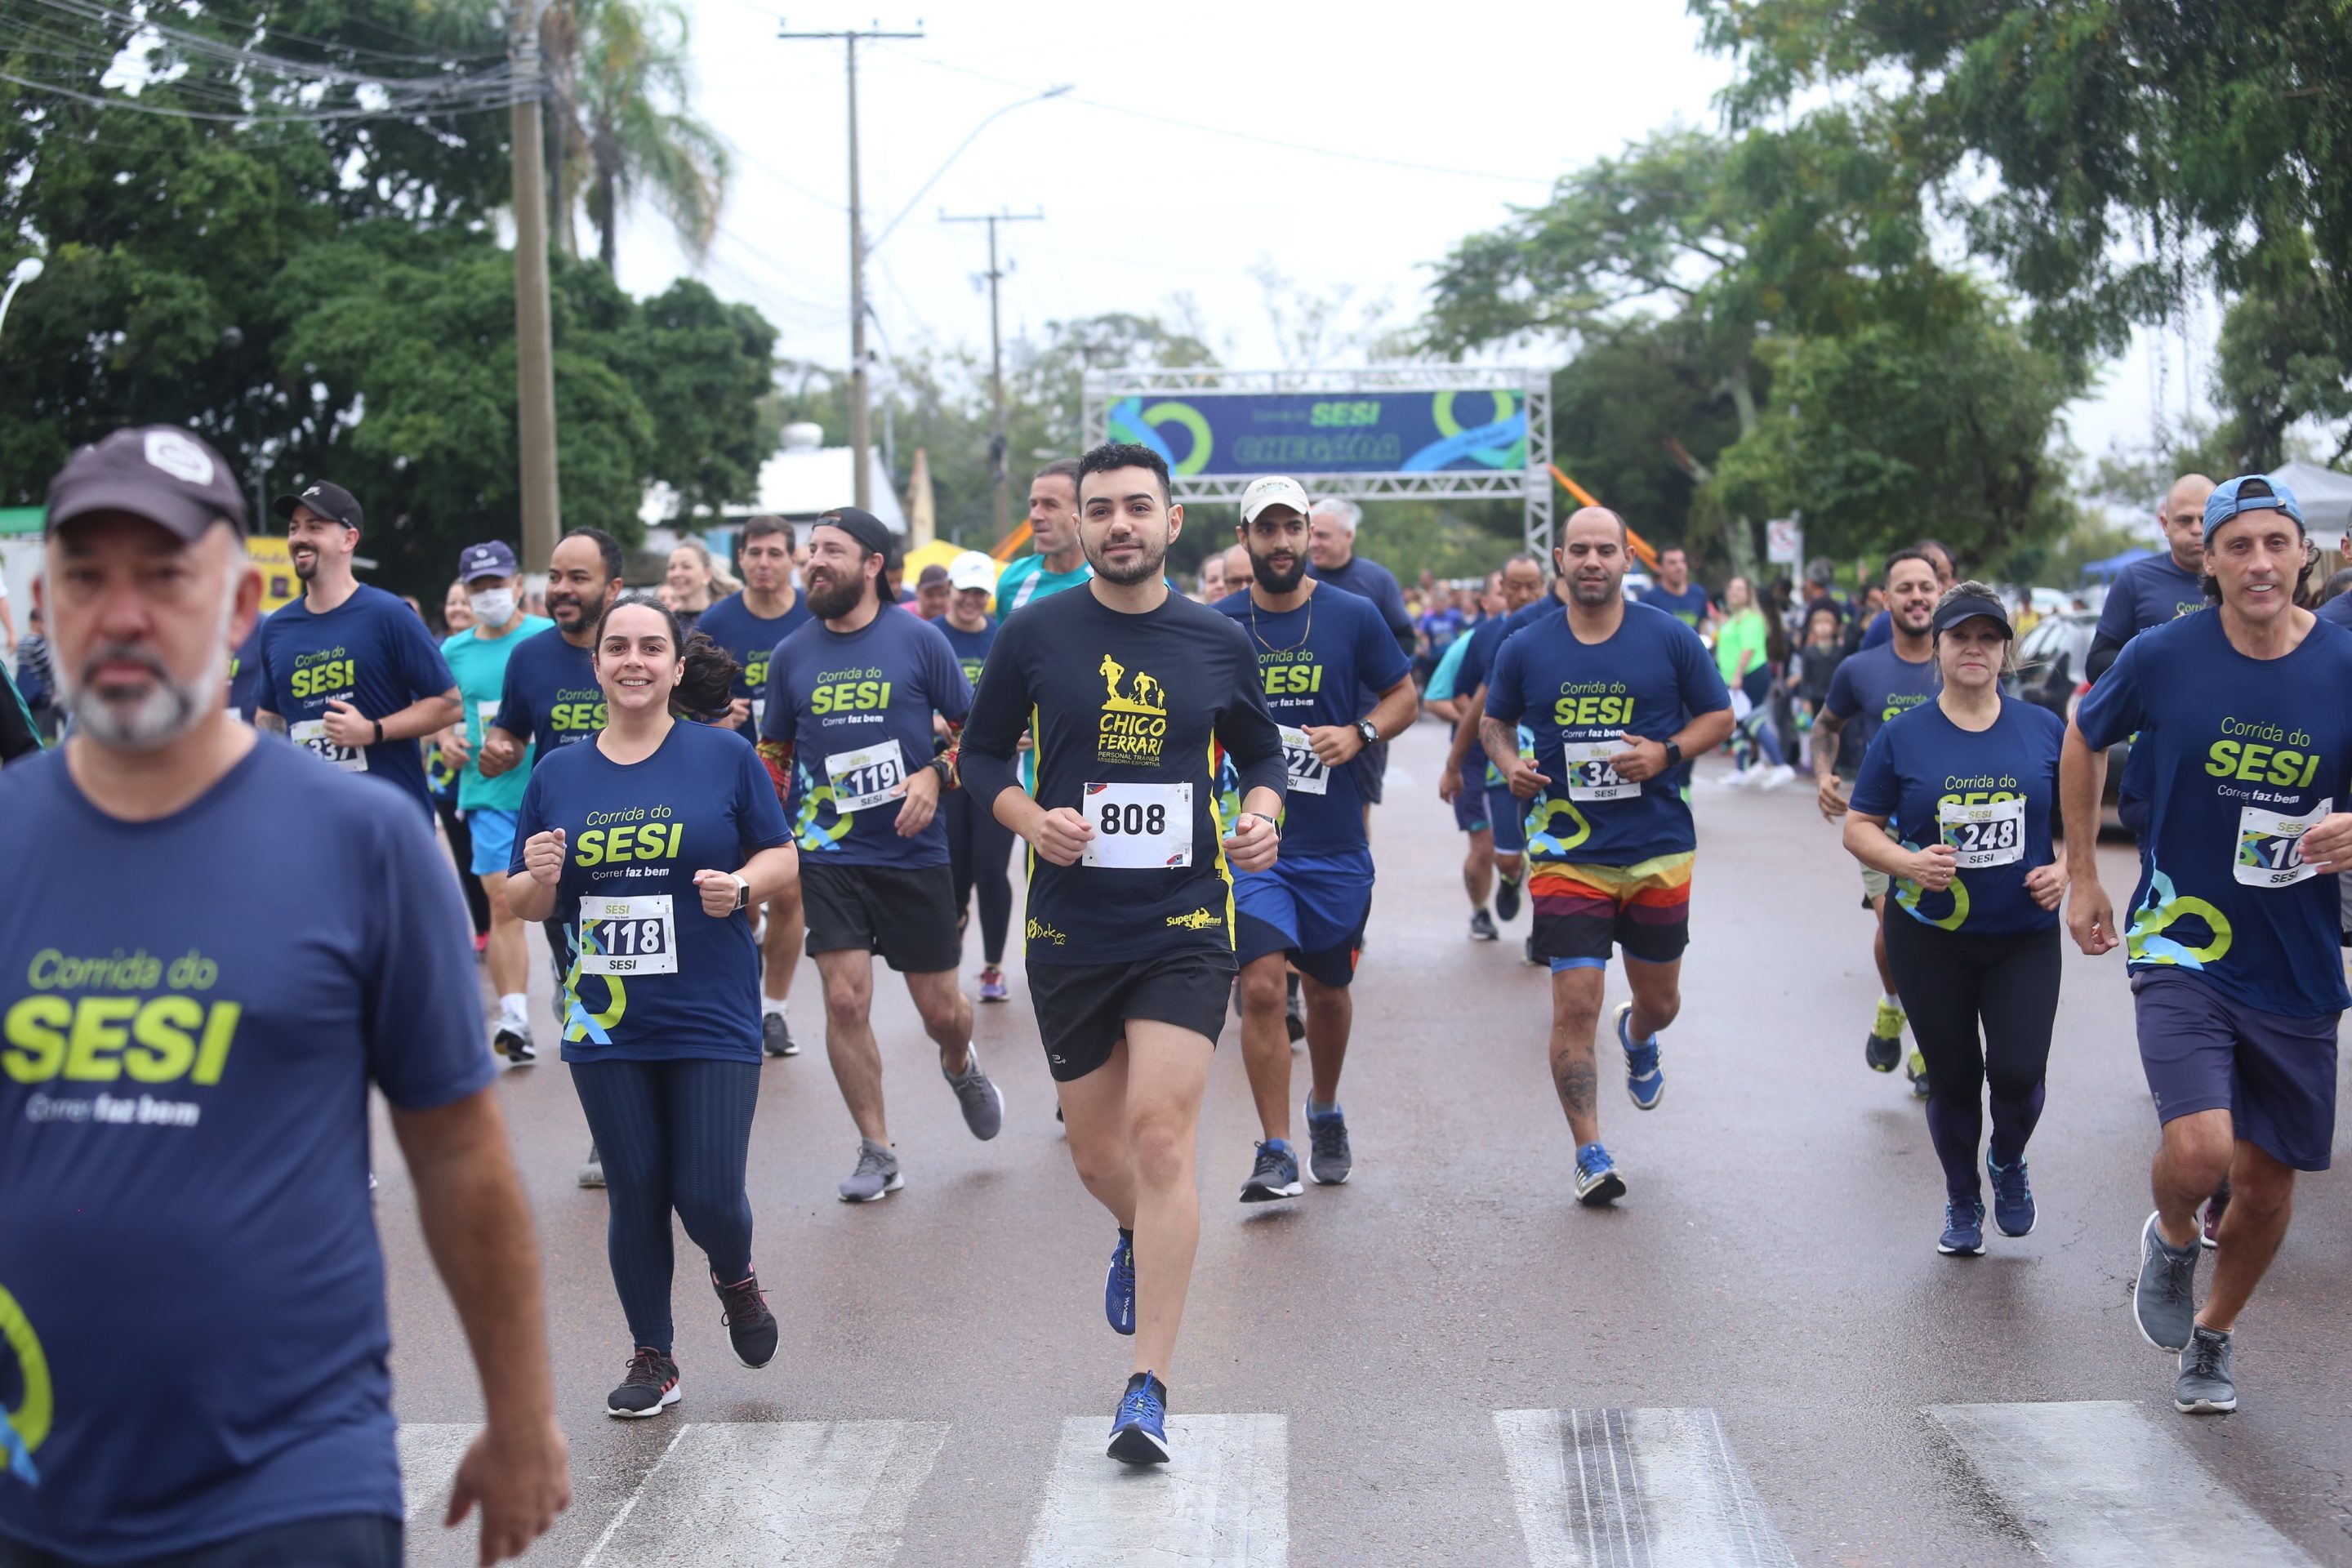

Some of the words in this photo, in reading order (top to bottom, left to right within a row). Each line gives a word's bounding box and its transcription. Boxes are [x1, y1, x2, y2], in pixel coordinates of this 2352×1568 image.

[1311, 401, 1380, 427] SESI
[2176, 601, 2204, 613] Corri
[295, 649, 329, 667] Corrida
[332, 645, 345, 659] do
[1258, 650, 1294, 664] orrida
[1297, 648, 1313, 662] do
[291, 659, 354, 698] SESI
[817, 667, 862, 684] Corrida
[866, 666, 882, 679] do
[556, 688, 599, 702] Corrida
[1561, 681, 1606, 694] Corrida
[1610, 681, 1626, 693] do
[811, 681, 891, 715] SESI
[1281, 698, 1294, 706] faz
[1295, 698, 1314, 706] bem
[550, 703, 608, 731] SES
[1554, 697, 1634, 725] SESI
[822, 716, 846, 726] Correr
[848, 715, 862, 724] faz
[863, 715, 884, 724] bem
[1100, 713, 1166, 737] CHICO
[1562, 729, 1586, 738] Correr
[1588, 728, 1602, 737] faz
[2221, 716, 2284, 742] Corrida
[2288, 728, 2310, 747] do
[1098, 734, 1163, 756] FERRARI
[1098, 751, 1132, 760] PERSONAL
[2205, 740, 2320, 787] SESI
[851, 762, 895, 795] 119
[1944, 774, 1994, 790] Corrida
[1999, 773, 2017, 788] do
[861, 794, 882, 806] SESI
[1594, 789, 1618, 798] SESI
[2217, 785, 2250, 800] Correr
[2252, 790, 2271, 801] faz
[2273, 792, 2299, 804] bem
[586, 805, 645, 826] Corrida
[650, 804, 671, 819] do
[1101, 804, 1165, 835] 808
[1968, 810, 1993, 819] SESI
[575, 822, 684, 866] SESI
[1962, 820, 2014, 851] 248
[1969, 853, 1993, 864] SESI
[591, 870, 623, 880] Correr
[626, 866, 642, 878] faz
[644, 866, 669, 877] bem
[2270, 870, 2298, 883] SESI
[605, 905, 630, 914] SESI
[1166, 914, 1193, 927] Super
[602, 920, 660, 954] 118
[28, 947, 163, 991] Corrida
[167, 947, 219, 991] do
[609, 960, 637, 970] SESI
[0, 994, 243, 1086] SESI
